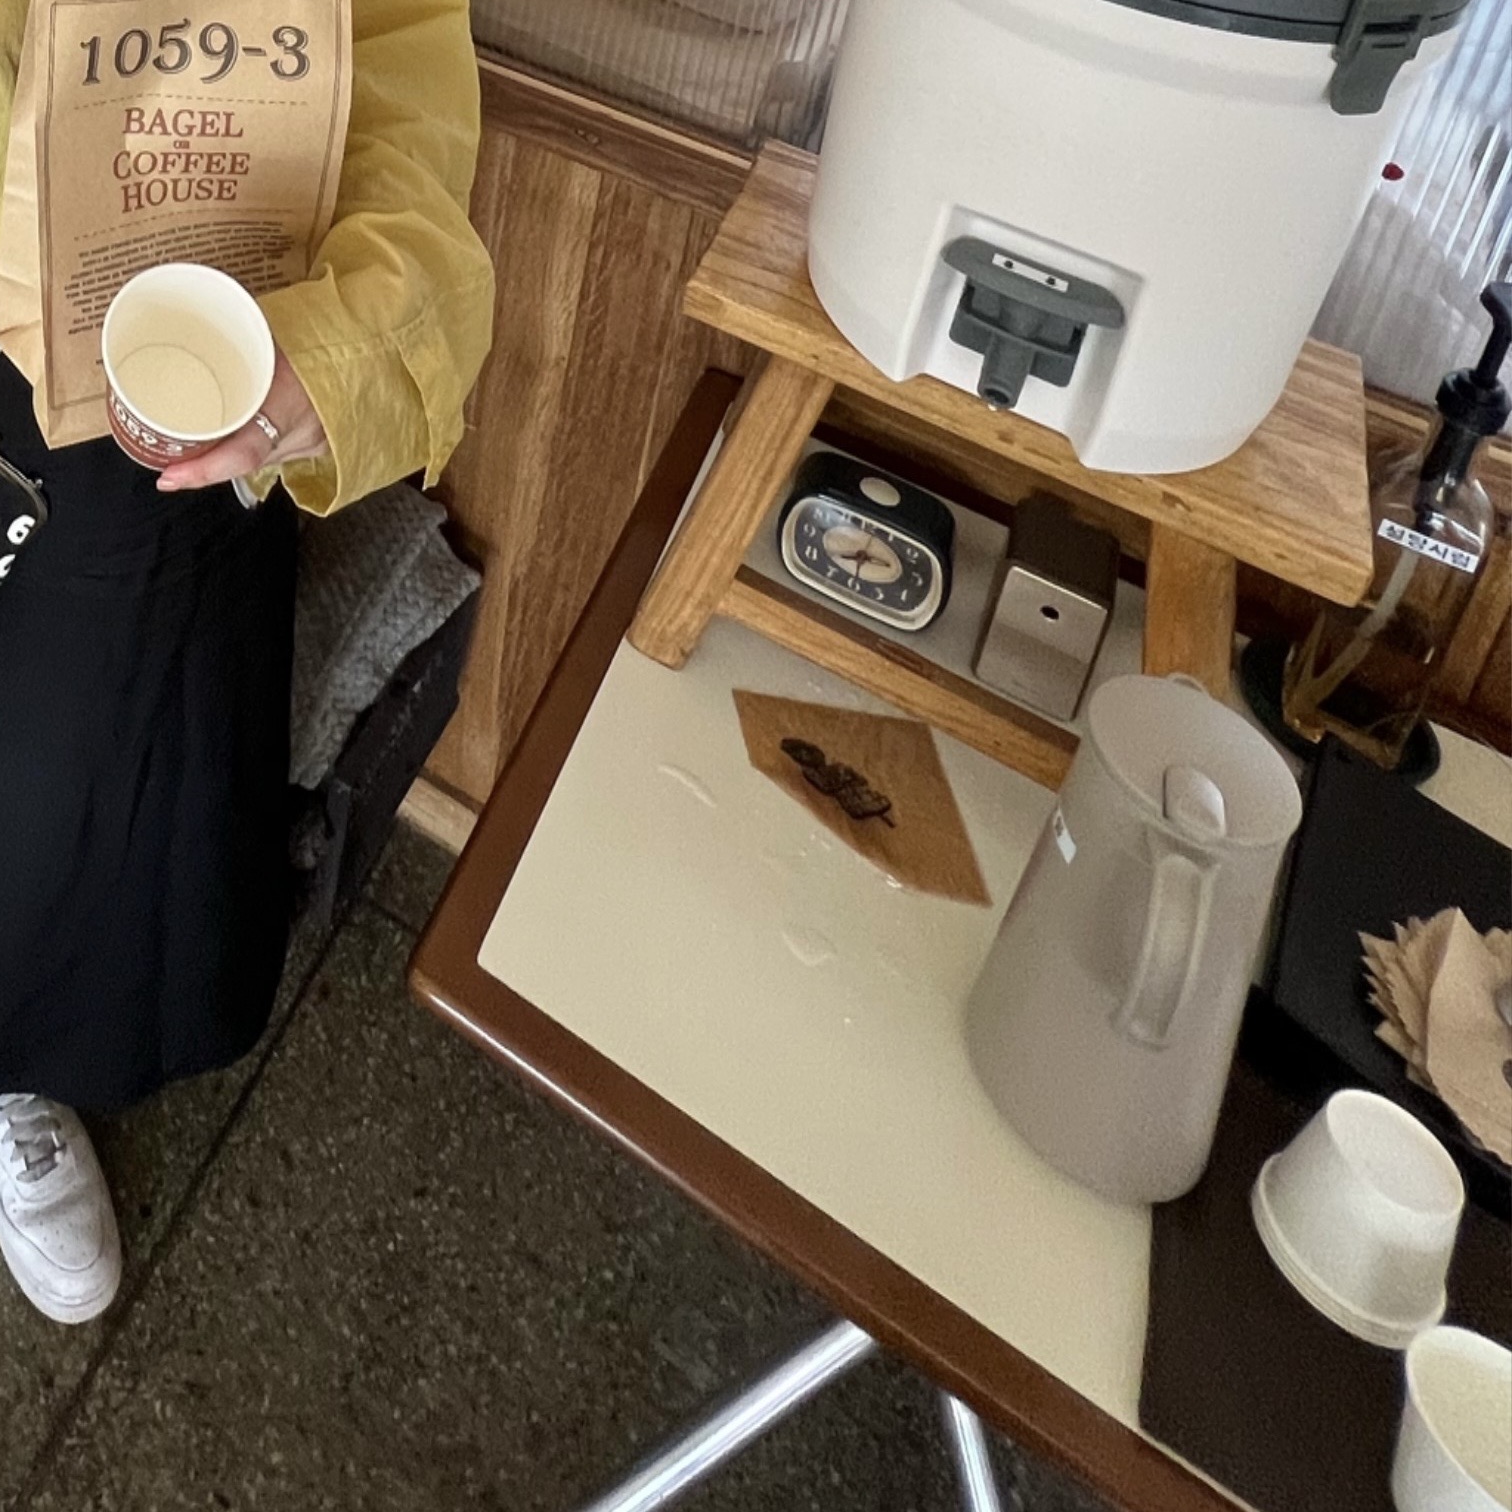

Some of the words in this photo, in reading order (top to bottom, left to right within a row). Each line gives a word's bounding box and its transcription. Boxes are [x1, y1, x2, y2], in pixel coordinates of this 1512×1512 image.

[78, 17, 312, 86] 1059-3
[121, 107, 245, 138] BAGEL
[112, 149, 251, 181] COFFEE
[120, 177, 239, 214] HOUSE
